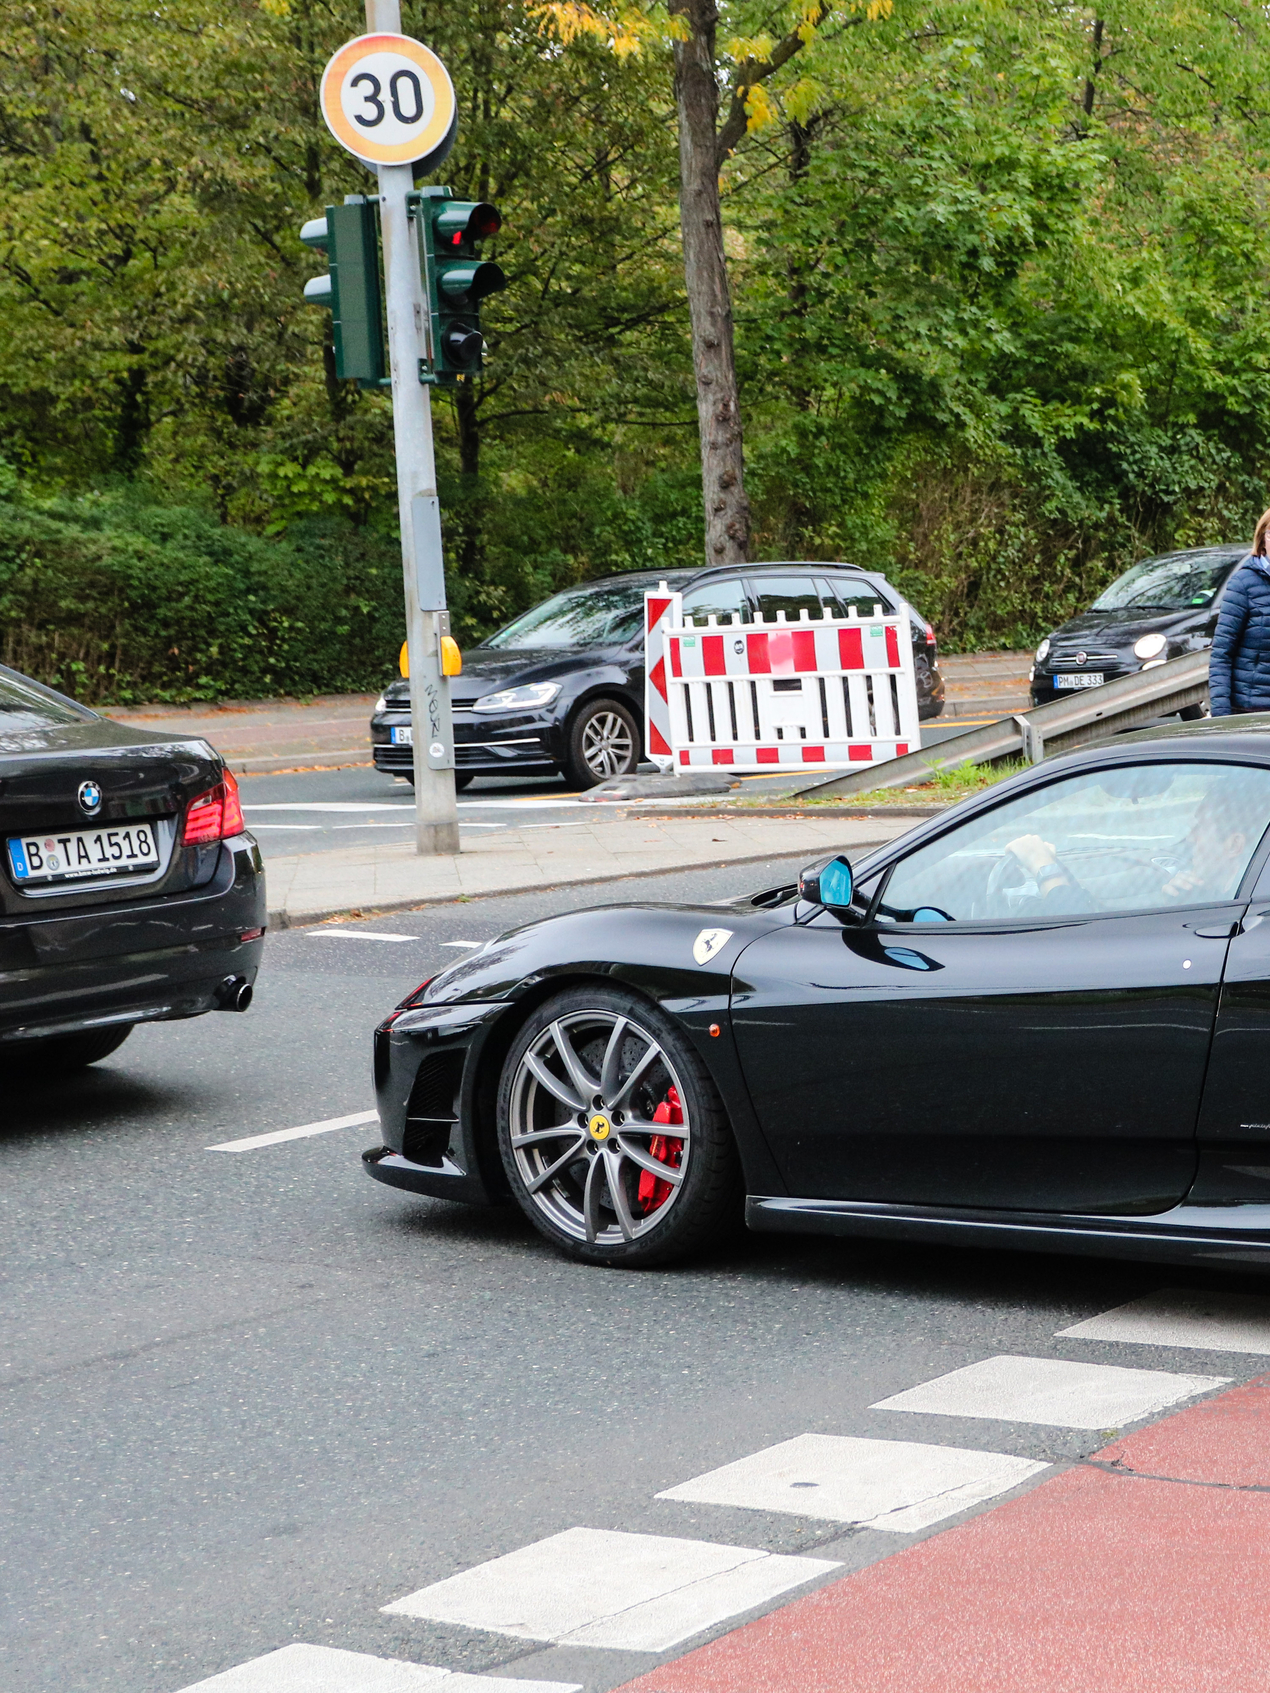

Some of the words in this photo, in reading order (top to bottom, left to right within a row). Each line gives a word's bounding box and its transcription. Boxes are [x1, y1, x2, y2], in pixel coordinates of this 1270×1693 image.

[350, 69, 424, 128] 30
[1059, 676, 1070, 687] PM
[1074, 676, 1085, 687] DE
[1087, 675, 1103, 685] 333
[25, 841, 44, 870] B
[57, 836, 91, 866] TA
[94, 829, 151, 862] 1518
